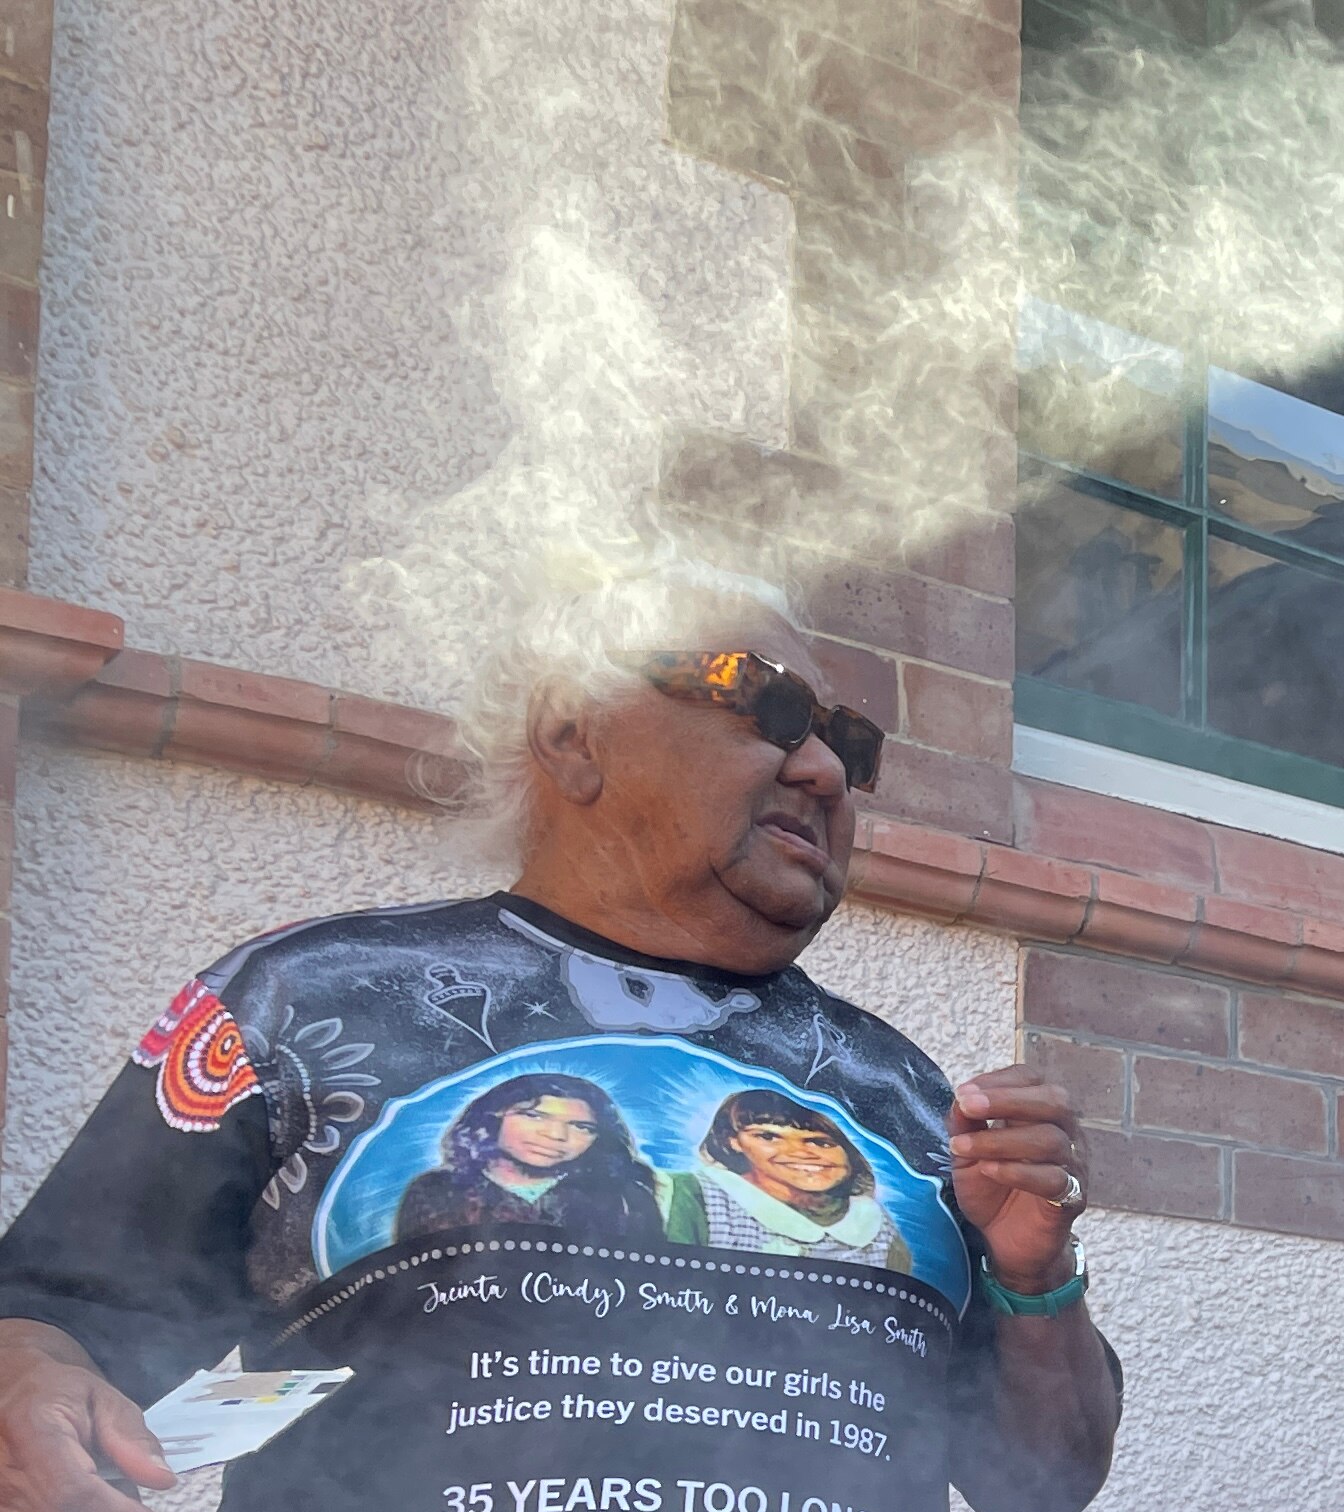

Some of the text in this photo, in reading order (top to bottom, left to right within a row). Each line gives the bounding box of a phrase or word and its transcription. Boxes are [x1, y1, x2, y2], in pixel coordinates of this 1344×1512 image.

[417, 1271, 929, 1358] Jacinta (Cindy) Smith & Mona Lisa Smith
[470, 1348, 886, 1413] It's time to give our girls the
[446, 1394, 892, 1461] justice they deserved in 1987.
